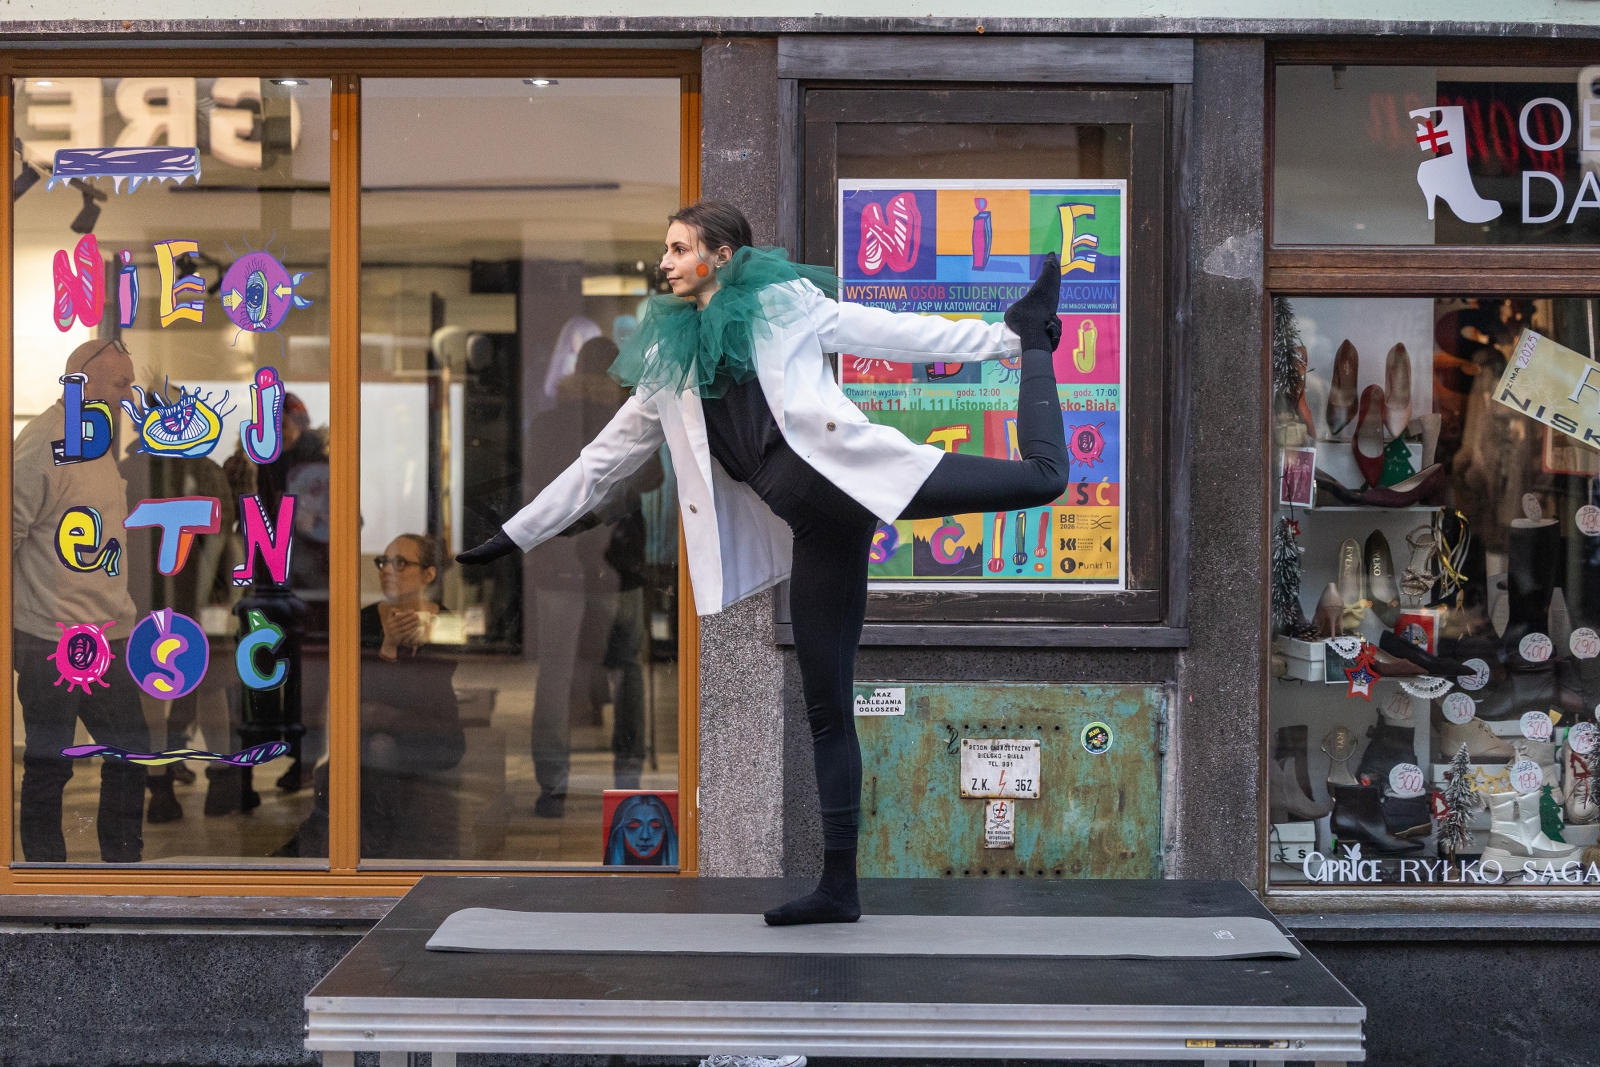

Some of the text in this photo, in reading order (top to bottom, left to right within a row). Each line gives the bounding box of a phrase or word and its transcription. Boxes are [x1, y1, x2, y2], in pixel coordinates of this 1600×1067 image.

[846, 283, 1117, 300] WYSTAWA OSÓB STUDENCKIC RACOWNI
[917, 301, 932, 311] ASP
[934, 301, 943, 311] W
[944, 301, 997, 311] KATOWICACH
[1506, 335, 1539, 390] ZIMA 2025
[846, 388, 877, 397] Otwarcie
[913, 388, 922, 396] 17
[956, 388, 977, 399] godz.
[979, 388, 1000, 397] 12:00
[1073, 388, 1094, 399] godz.
[1095, 388, 1118, 397] 17:00
[850, 398, 883, 411] unkt
[886, 399, 907, 413] 11,
[909, 398, 926, 411] ul.
[929, 399, 944, 411] 11
[949, 398, 1009, 412] Listopada
[1060, 399, 1117, 412] sko-Biała
[1078, 562, 1103, 570] Punkt
[859, 705, 900, 713] OGŁOSZEŃ
[1014, 779, 1033, 792] 362
[1303, 851, 1383, 883] CAPRICE
[1400, 859, 1503, 884] RYŁKO
